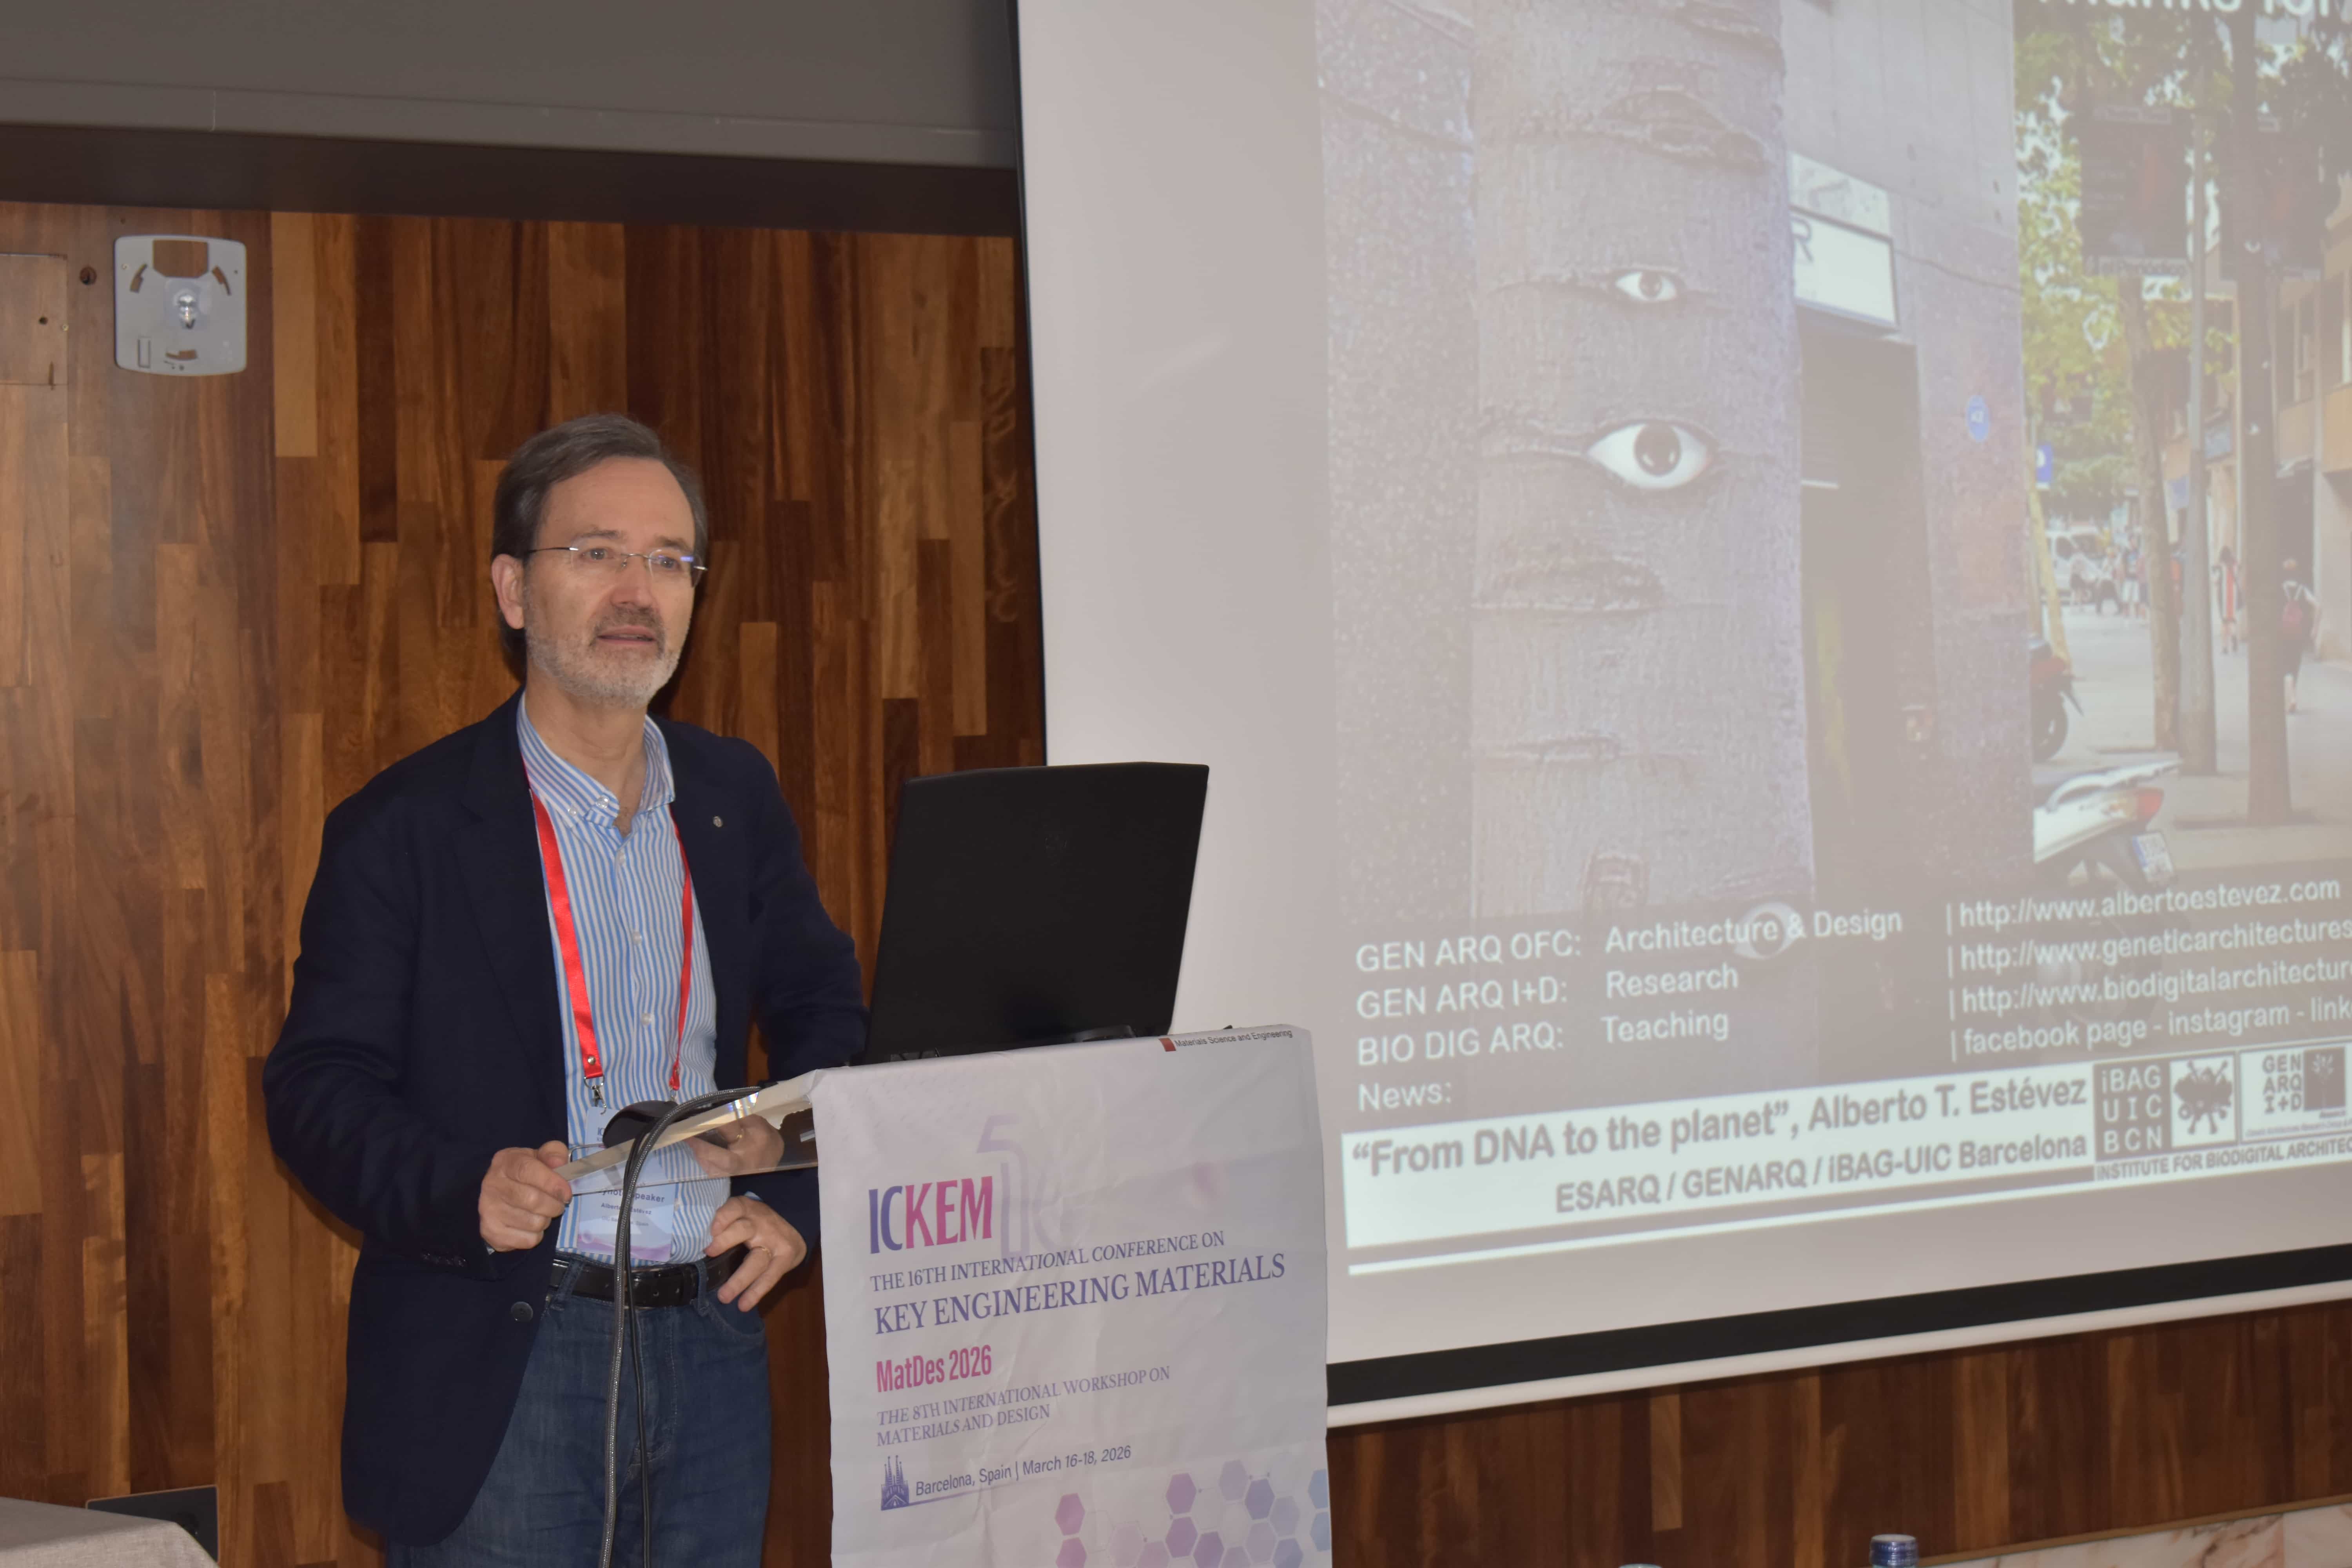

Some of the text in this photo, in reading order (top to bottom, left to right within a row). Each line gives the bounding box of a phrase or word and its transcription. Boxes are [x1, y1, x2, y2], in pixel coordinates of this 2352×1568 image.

[1960, 879, 2340, 932] http://www.albertoestevez.com
[1356, 929, 1581, 972] GEN ARQ OFC:
[1605, 908, 1903, 954] Architecture & Design
[1356, 976, 1567, 1019] GEN ARQ I+D:
[1606, 963, 1738, 998] Research
[1962, 958, 2352, 1018] http://www.biodigitalarchitectur
[1174, 1038, 1207, 1047] Materials
[1208, 1035, 1236, 1044] Science
[1252, 1030, 1292, 1041] Engineering
[1358, 1021, 1563, 1066] BIO DIG ARQ:
[1602, 1009, 1729, 1043] Teaching
[1964, 1020, 2080, 1054] facebook
[2087, 1019, 2147, 1051] page
[2169, 1005, 2289, 1036] instagram
[2311, 995, 2352, 1022] link
[2262, 1053, 2301, 1073] GEN
[2263, 1074, 2302, 1095] ARQ
[1358, 1082, 1451, 1112] News:
[2265, 1093, 2302, 1114] I+D
[1352, 1140, 1463, 1176] “From
[1474, 1124, 1554, 1165] DNA
[1563, 1120, 1597, 1155] to
[1607, 1115, 1661, 1151] the
[1808, 1089, 1927, 1131] Alberto
[1934, 1084, 1959, 1117] T.
[1970, 1076, 2087, 1114] Estévez
[1556, 1174, 1661, 1213] ESARQ
[1682, 1158, 1807, 1198] GENARQ
[1959, 1134, 2087, 1169] Barcelona
[2096, 1157, 2169, 1180] INSTITUTE
[2173, 1152, 2203, 1172] FOR
[869, 1176, 993, 1254] ICKEM
[870, 1231, 1224, 1292] THE 16TH INTERNATIONAL CONFERENCE ON
[875, 1253, 1285, 1334] KEY ENGINEERING MATERIALS
[877, 1345, 991, 1392] MatDes 2026
[877, 1366, 1170, 1425] THE 8TH INTERNATIONAL WORKSHOP ON
[877, 1404, 1050, 1446] MATERIALS AND DESIGN
[916, 1474, 975, 1496] Barcelona,
[979, 1465, 1011, 1485] Spain
[1023, 1456, 1061, 1475] March
[1065, 1451, 1097, 1468] 16-18,
[1101, 1445, 1131, 1462] 2026
